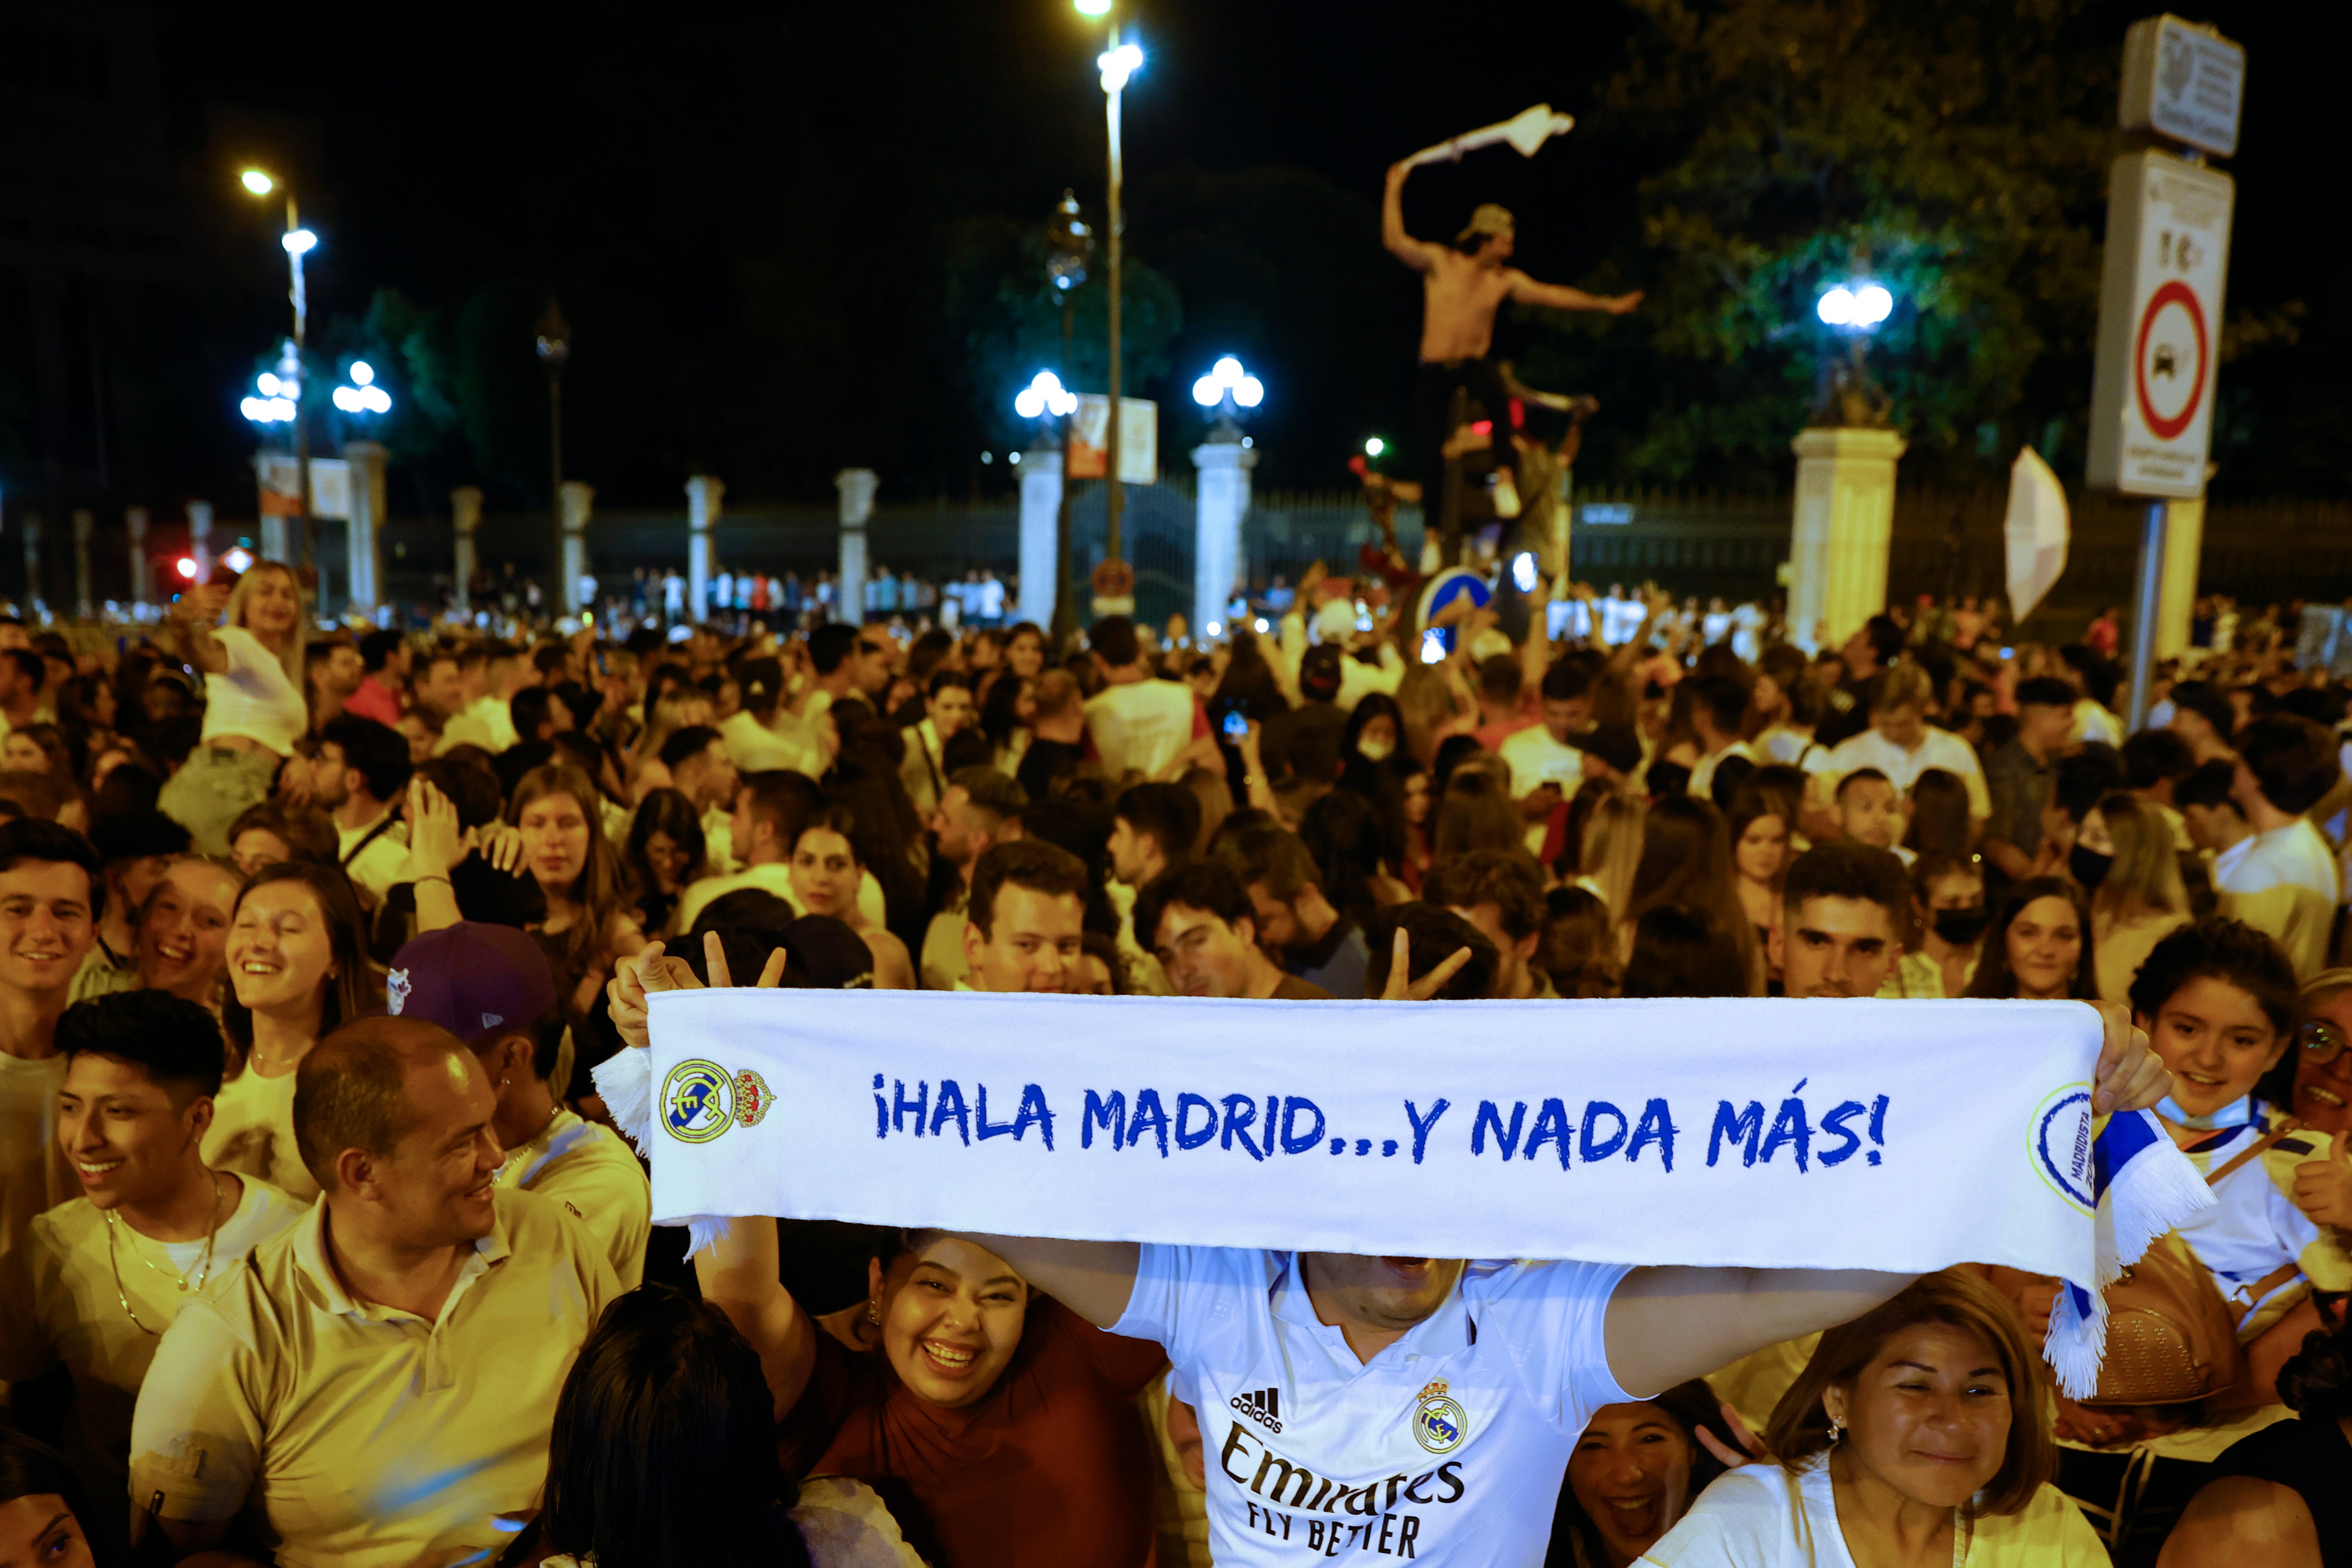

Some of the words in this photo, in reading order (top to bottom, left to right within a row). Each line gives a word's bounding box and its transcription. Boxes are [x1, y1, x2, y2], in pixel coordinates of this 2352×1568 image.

[872, 1073, 1056, 1152] ¡HALA
[1470, 1097, 1680, 1173] NADA
[1706, 1078, 1890, 1174] MÁS!
[2071, 1111, 2090, 1181] MADRIDISTA
[1231, 1397, 1283, 1433] adidas
[1222, 1421, 1464, 1516] Emirates
[1247, 1501, 1291, 1540] FLY
